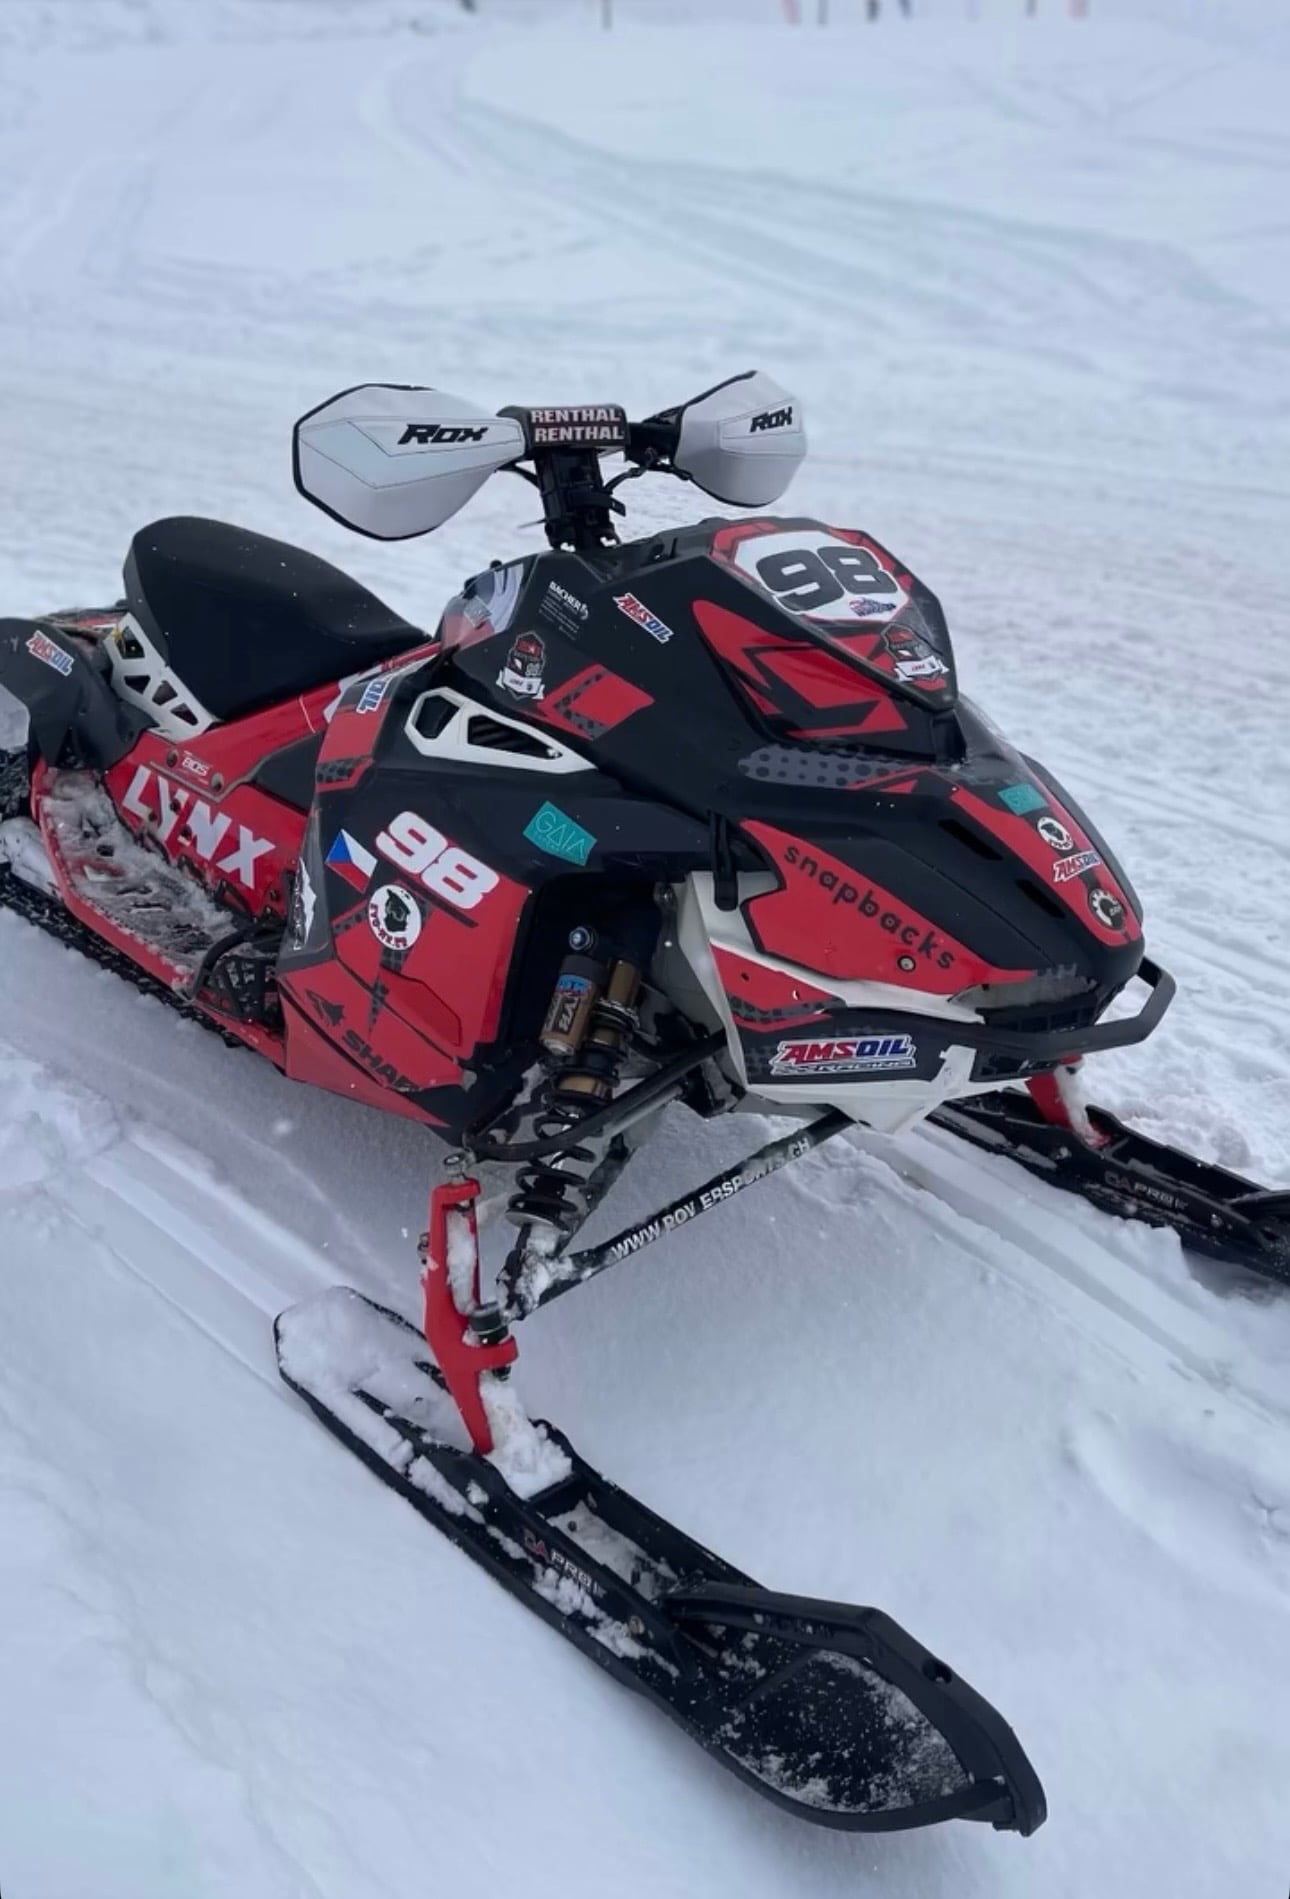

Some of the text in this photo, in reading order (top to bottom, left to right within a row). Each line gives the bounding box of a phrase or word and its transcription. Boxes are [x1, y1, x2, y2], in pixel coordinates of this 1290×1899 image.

[531, 408, 622, 423] RENTHAL
[535, 426, 624, 442] RENTHAL
[755, 546, 898, 612] 98
[122, 765, 276, 890] LYNX
[375, 811, 500, 909] 98
[784, 846, 956, 969] snapbacks
[779, 1039, 909, 1065] AMSOIL
